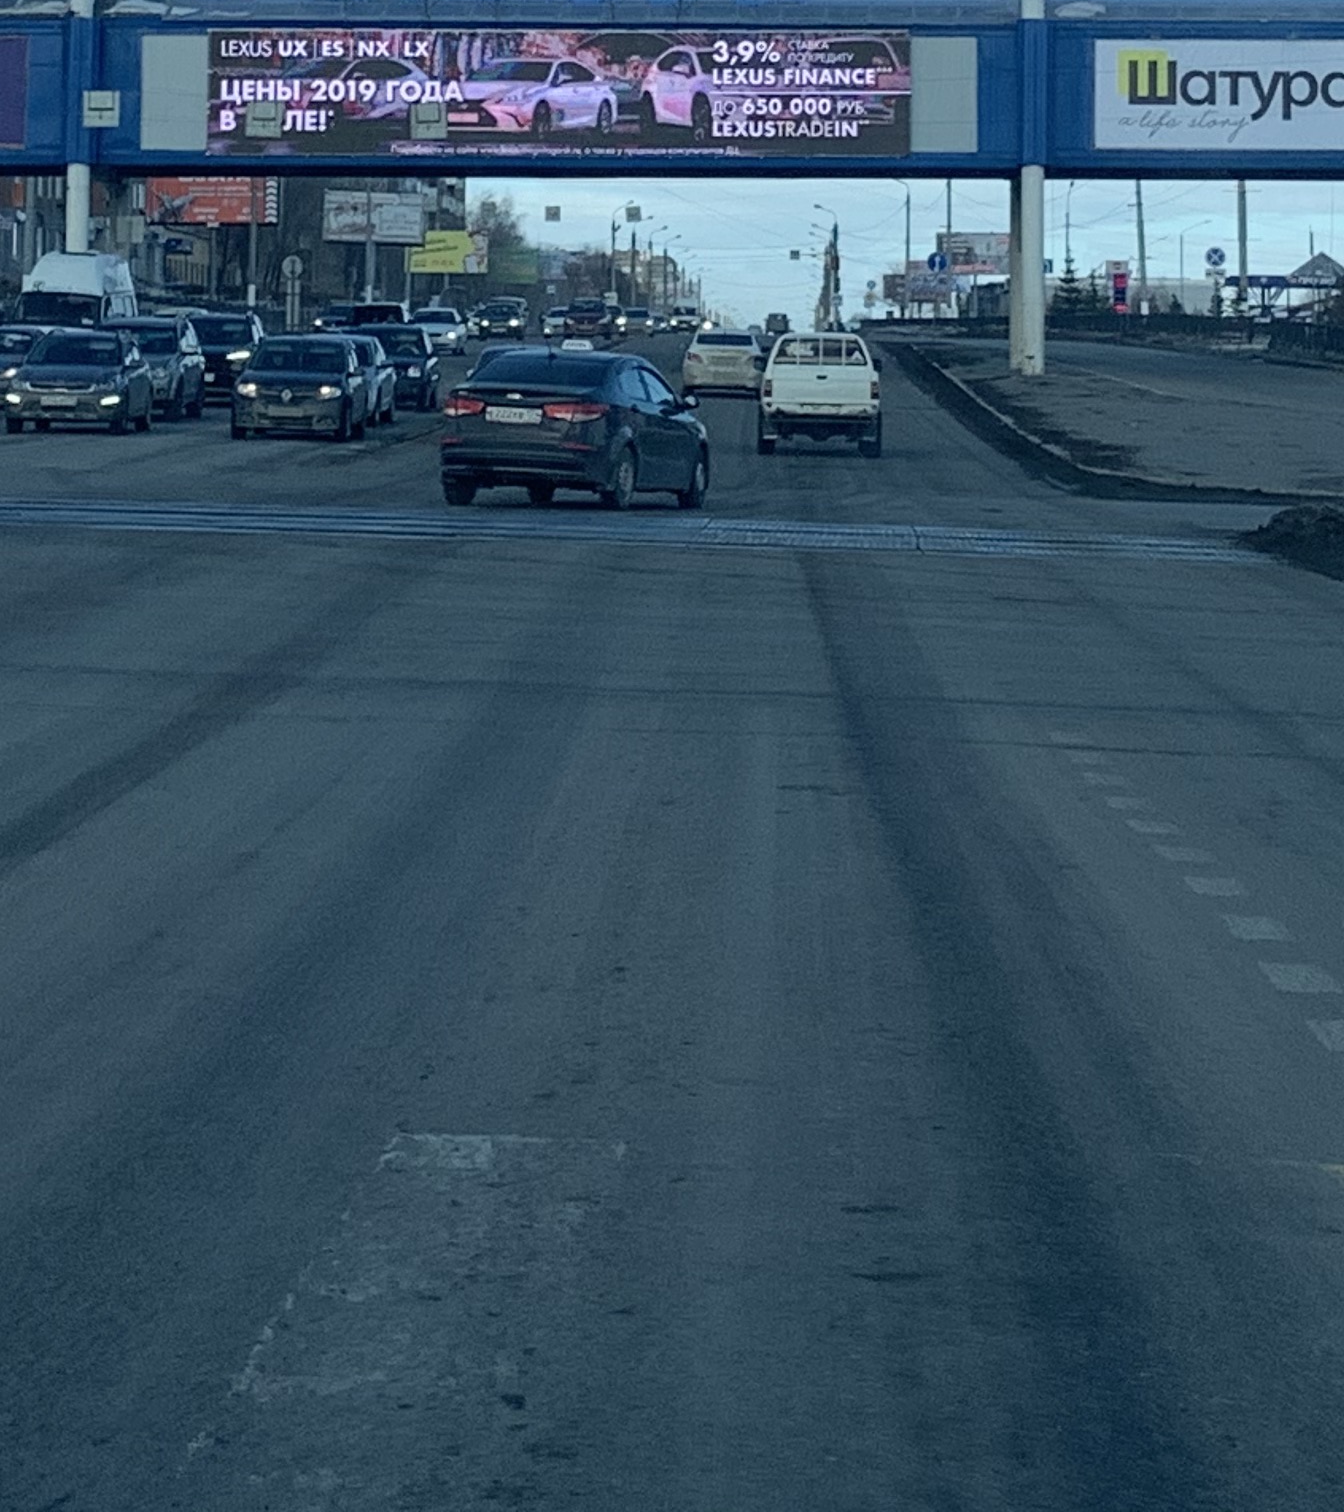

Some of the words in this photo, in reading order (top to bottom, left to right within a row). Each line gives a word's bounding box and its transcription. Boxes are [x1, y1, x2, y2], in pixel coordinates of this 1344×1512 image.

[220, 40, 272, 57] LEXUS
[278, 40, 308, 57] UX
[321, 40, 345, 57] ES
[358, 40, 390, 57] NX
[404, 40, 429, 57] LX
[711, 40, 781, 65] 3,9%
[712, 68, 776, 85] LEXUS
[220, 79, 301, 105] ЦЕНЫ
[311, 80, 377, 102] 2019
[386, 80, 465, 105] ГОДА
[712, 101, 737, 115] ДО
[742, 99, 783, 115] 650
[790, 99, 832, 115] 000
[220, 110, 236, 131] В
[1188, 110, 1249, 143] story
